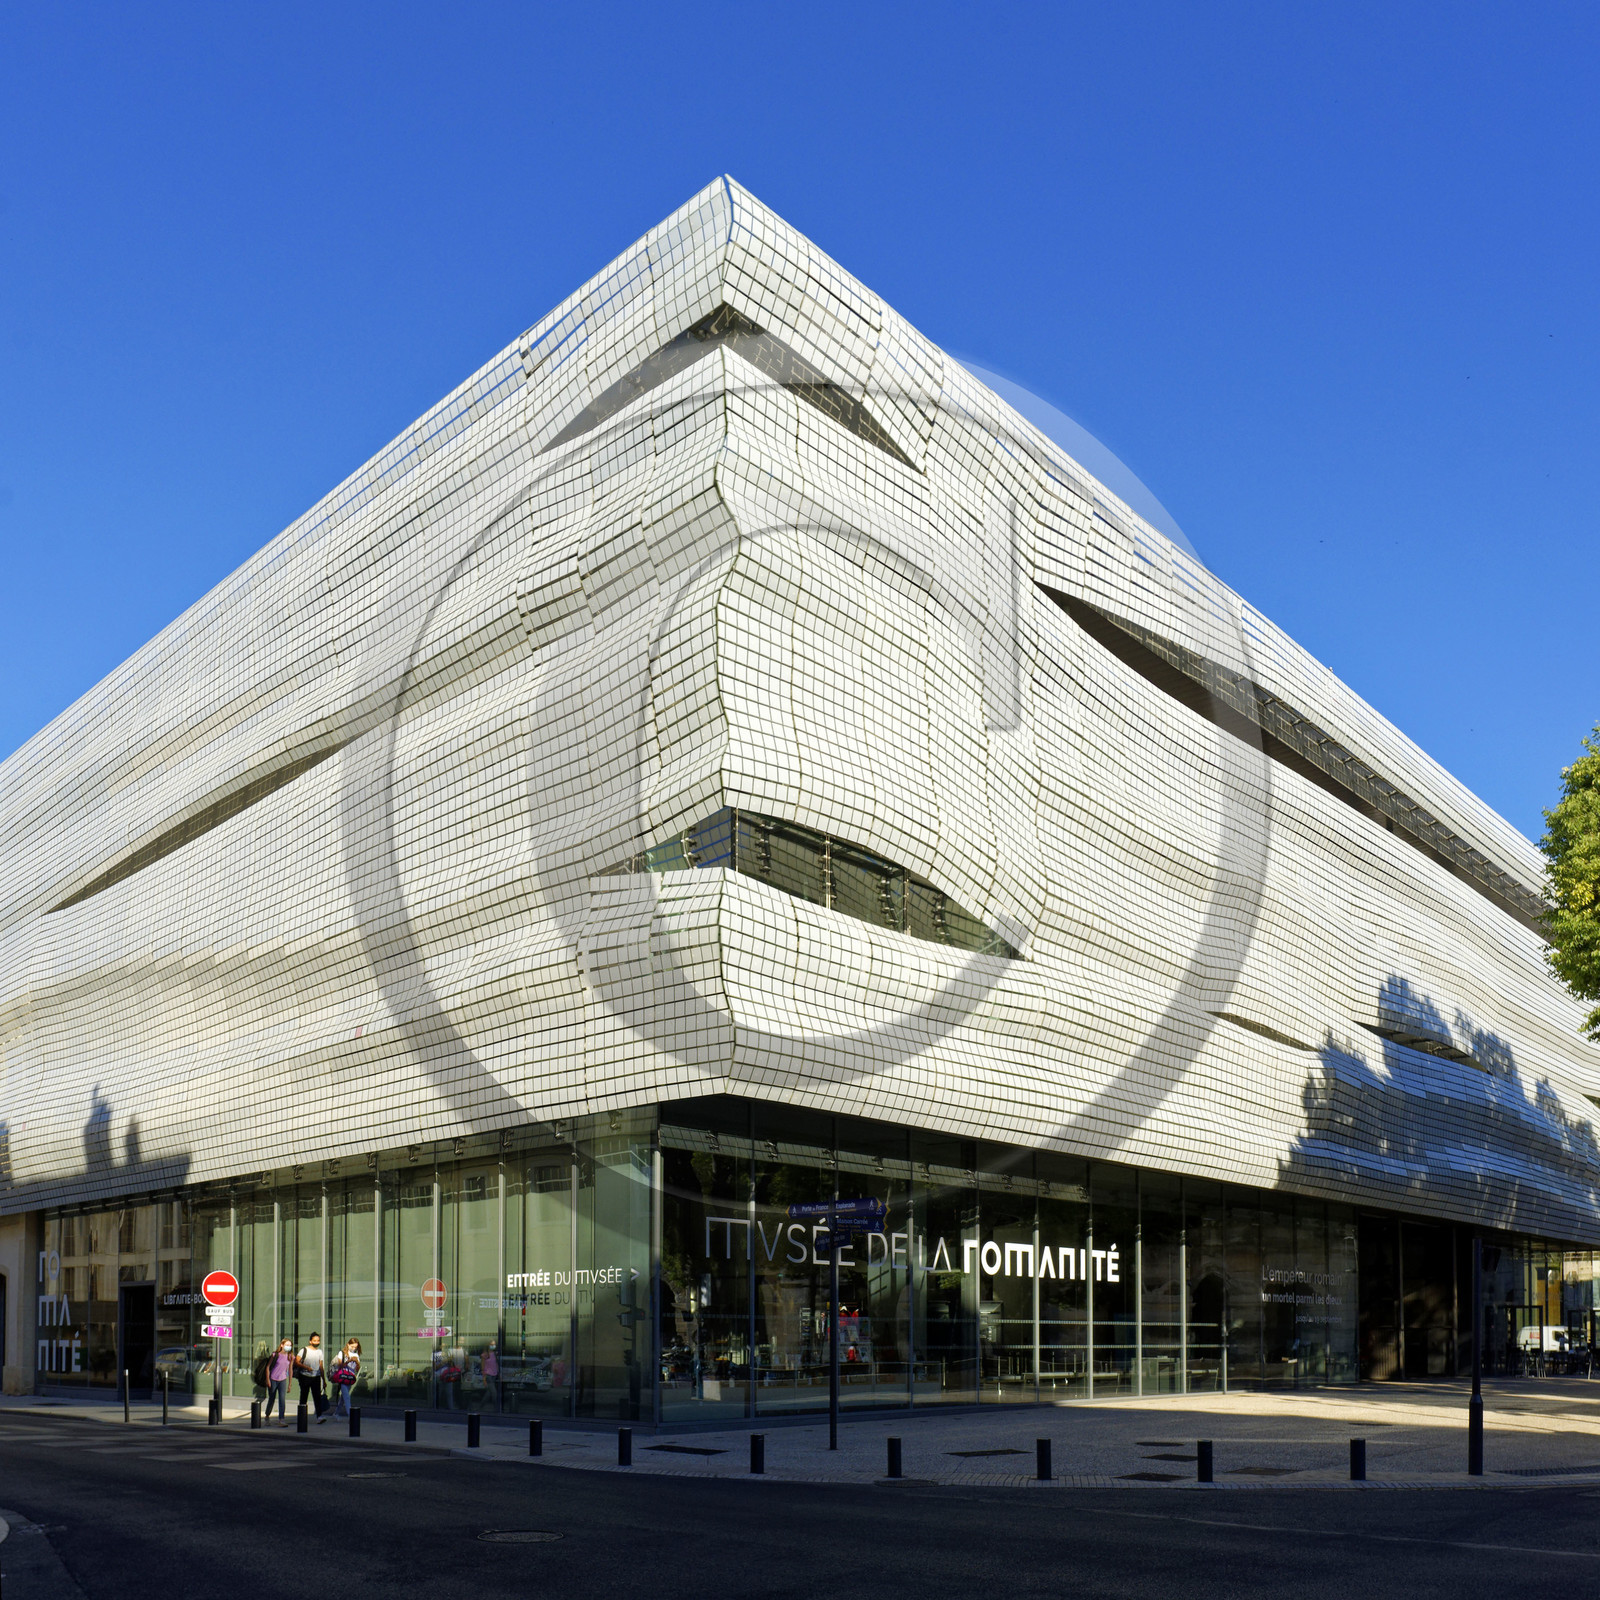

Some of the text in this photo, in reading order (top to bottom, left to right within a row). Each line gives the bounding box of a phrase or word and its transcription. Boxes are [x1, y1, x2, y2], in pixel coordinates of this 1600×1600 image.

[867, 1232, 908, 1270] DE
[918, 1236, 952, 1272] LA
[554, 1271, 571, 1286] DU
[1262, 1264, 1342, 1287] L'empereur romain
[1262, 1291, 1342, 1305] un mortel parmi les dieux
